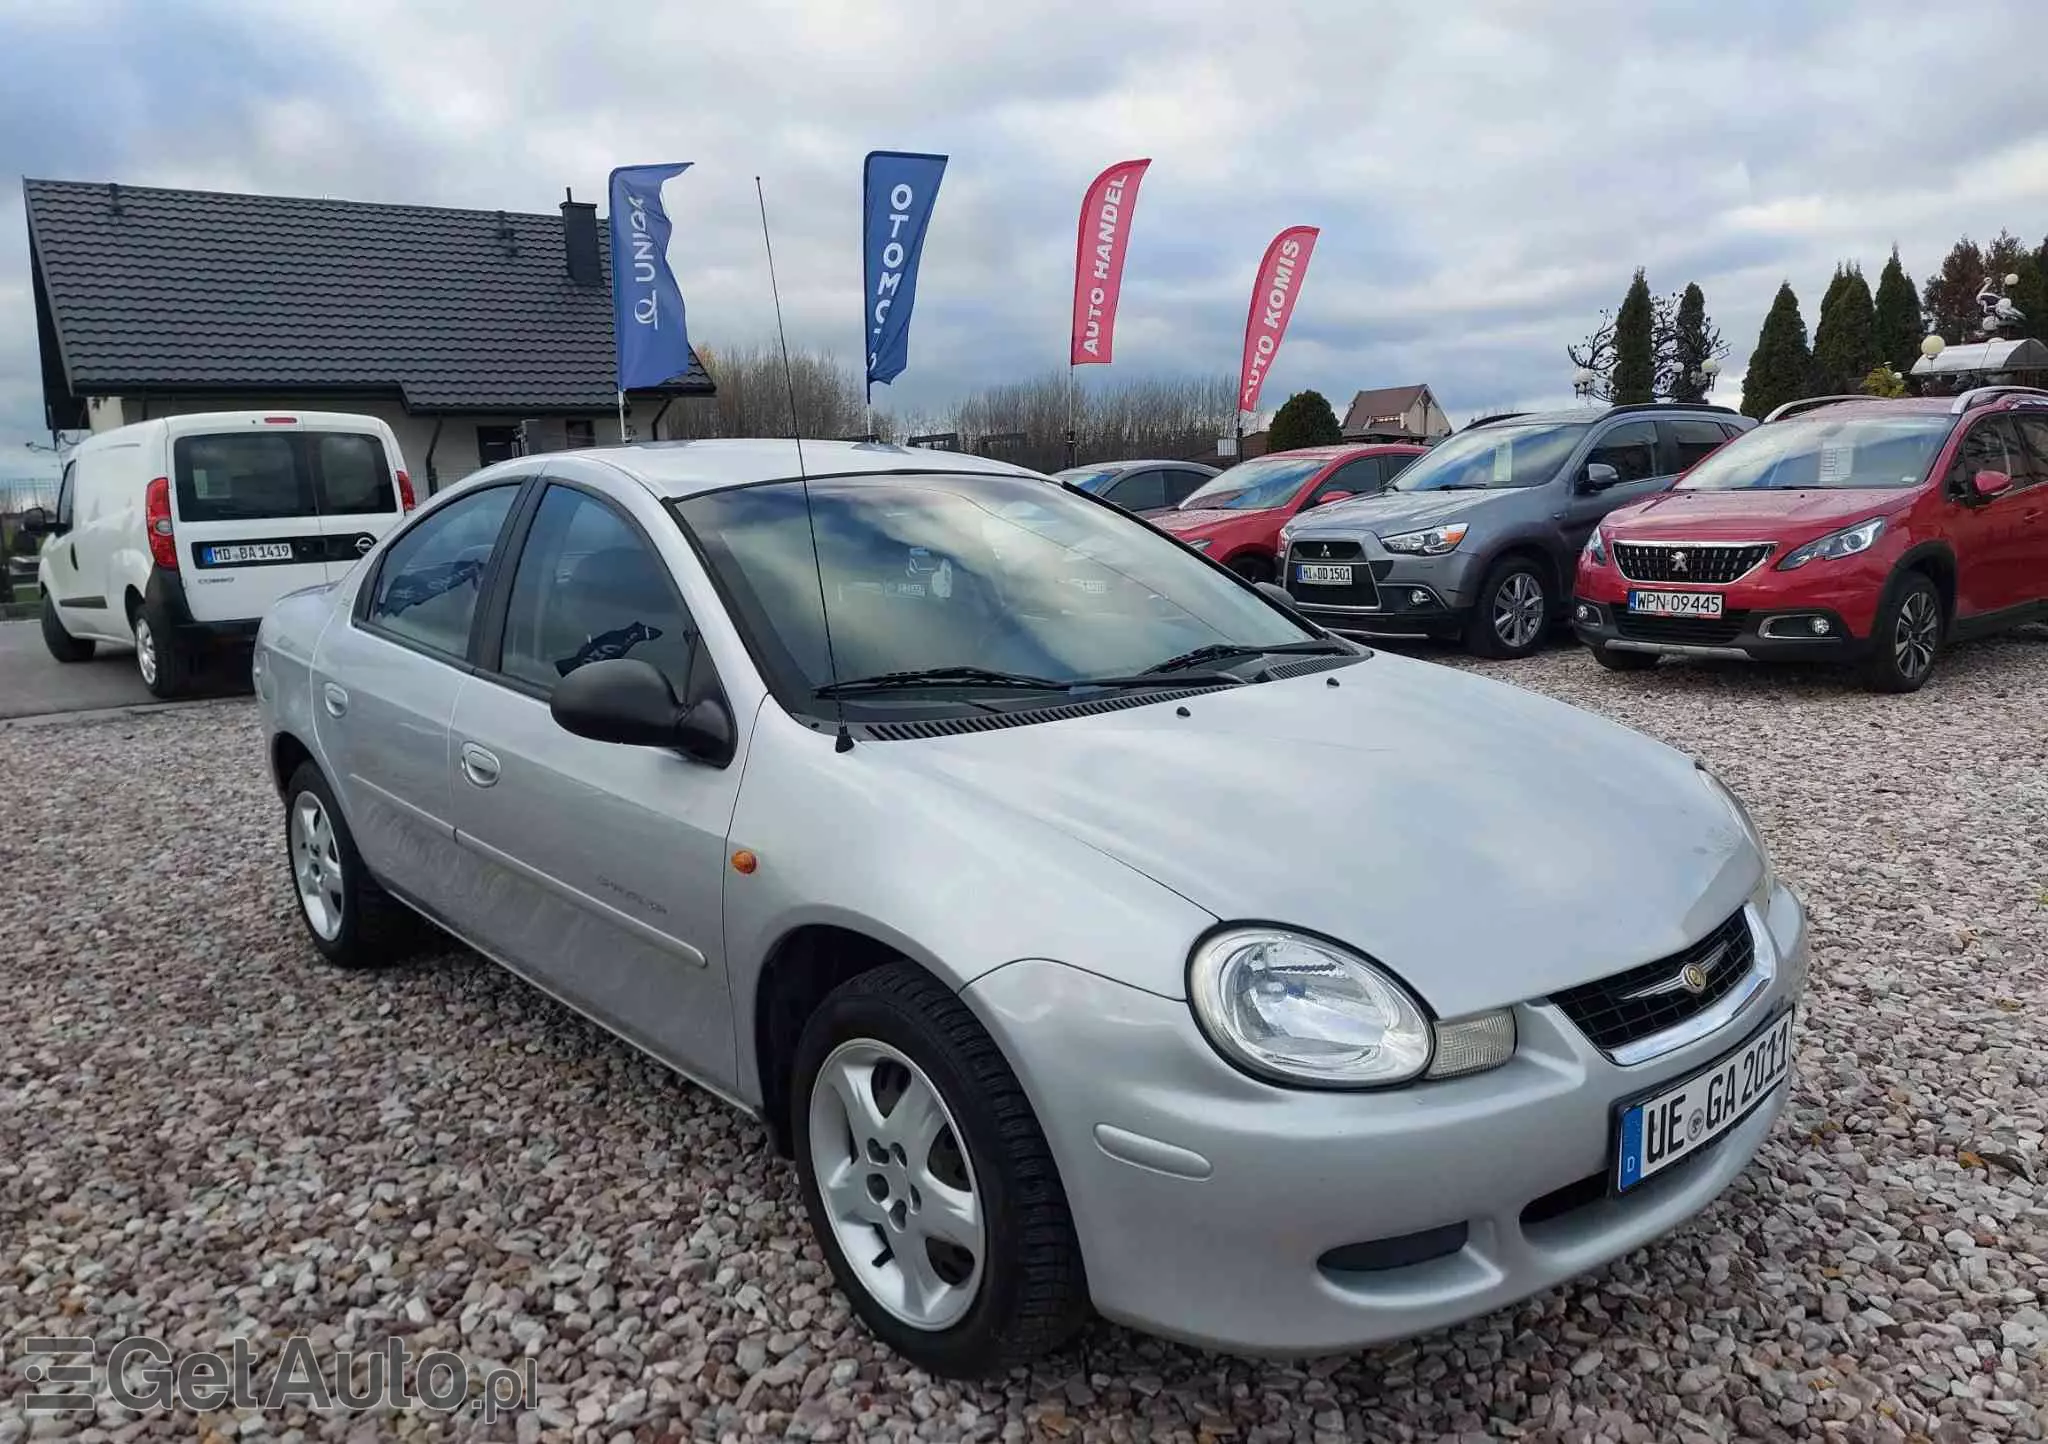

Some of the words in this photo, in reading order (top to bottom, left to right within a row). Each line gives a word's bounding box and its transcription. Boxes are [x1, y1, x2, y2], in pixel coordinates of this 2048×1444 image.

[869, 183, 914, 370] OTOMO
[1083, 287, 1105, 356] AUTO
[1094, 175, 1128, 280] HANDEL
[1263, 238, 1301, 329] KOMIS
[1636, 593, 1666, 610] WPN
[1671, 595, 1720, 613] 09445
[1647, 1093, 1687, 1164] UE
[1706, 1063, 1737, 1131] GA
[1741, 1021, 1788, 1105] 2011
